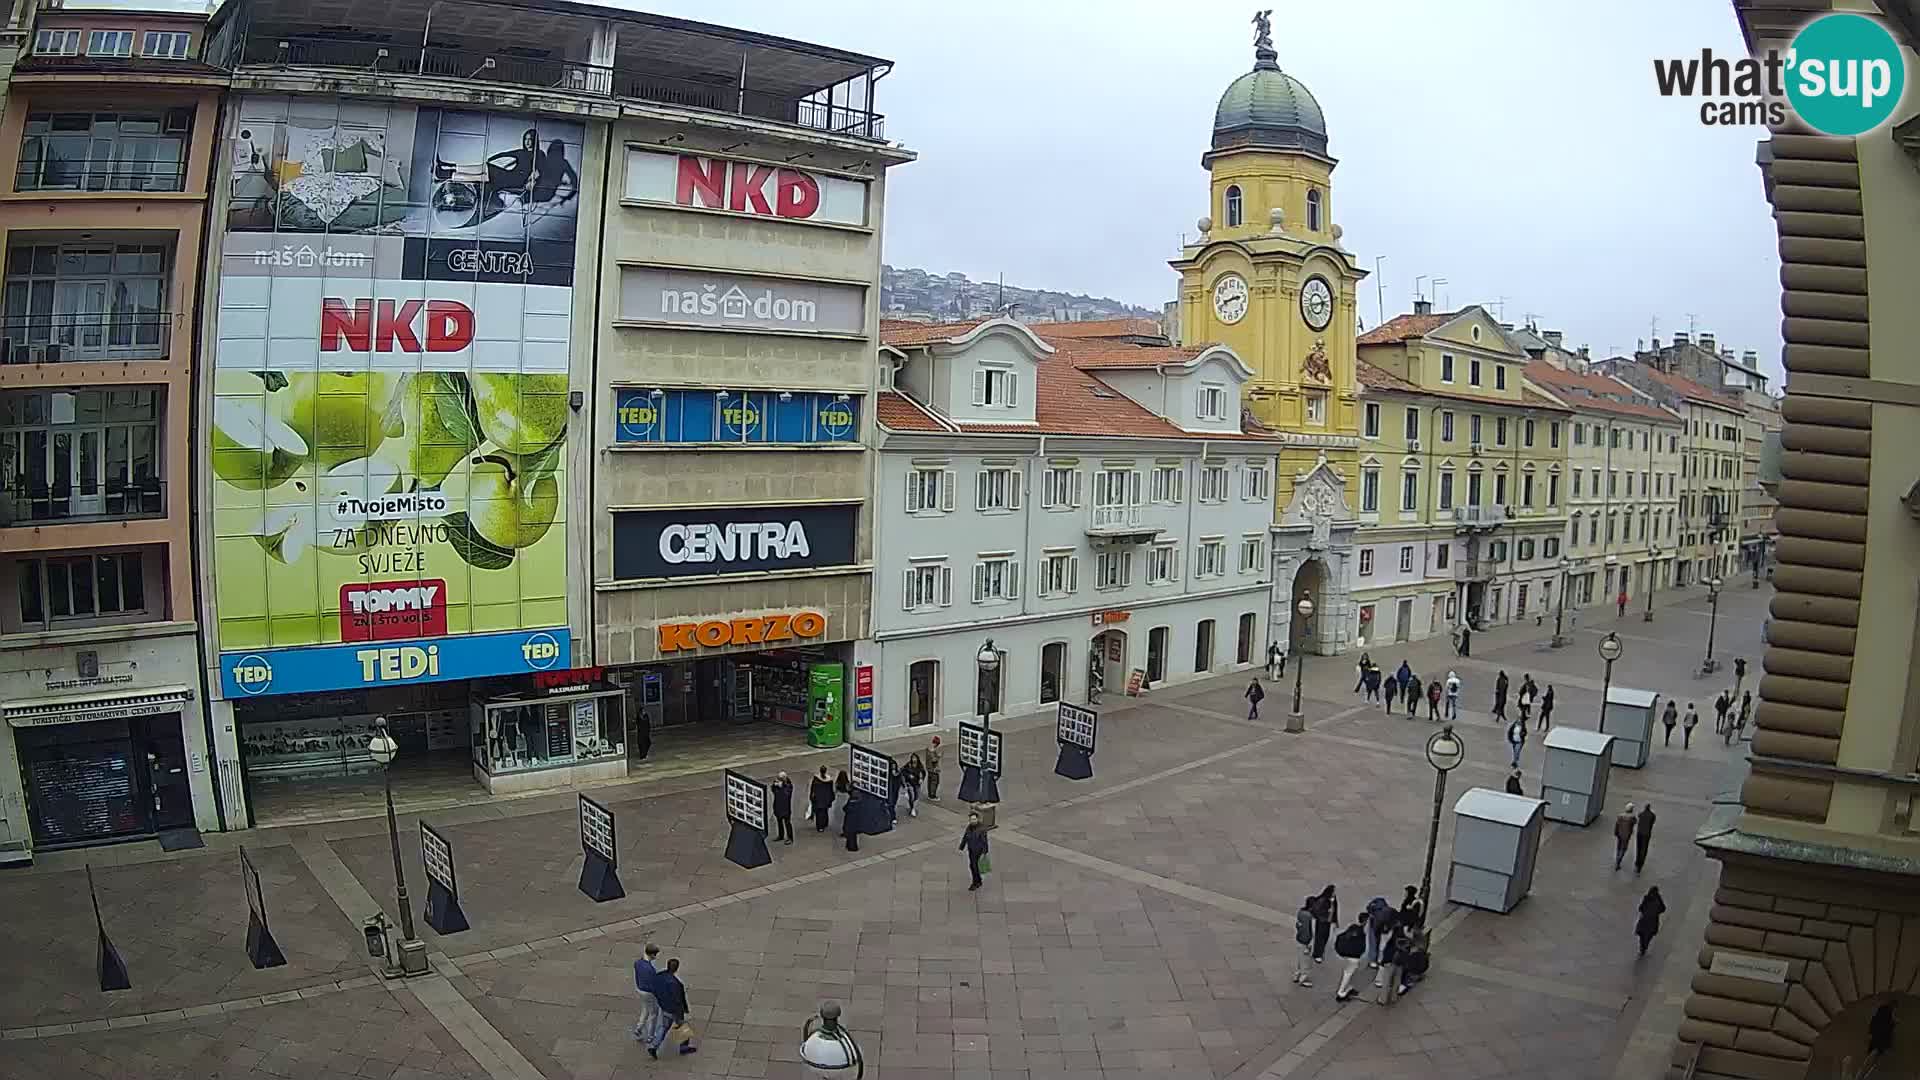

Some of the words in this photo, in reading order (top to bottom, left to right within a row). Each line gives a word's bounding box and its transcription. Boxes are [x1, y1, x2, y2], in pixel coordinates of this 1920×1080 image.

[676, 154, 821, 218] NKD
[254, 245, 293, 266] naš
[319, 246, 365, 267] dom
[448, 249, 534, 275] CENTRA
[661, 283, 717, 315] naš
[753, 290, 816, 322] dom
[320, 297, 477, 353] NKD
[618, 407, 657, 425] TEDi
[723, 408, 759, 426] TEDi
[820, 411, 853, 426] TEDi
[338, 496, 446, 516] #TvojeMisto
[333, 528, 357, 548] ZA
[365, 523, 450, 548] DNEVNO
[659, 520, 810, 564] CENTRA
[358, 547, 425, 575] SVJEŽE
[348, 586, 438, 614] TOMMY
[658, 612, 826, 652] KORZO
[357, 645, 439, 681] TEDi
[522, 640, 560, 660] TEDi
[232, 665, 273, 683] TEDi
